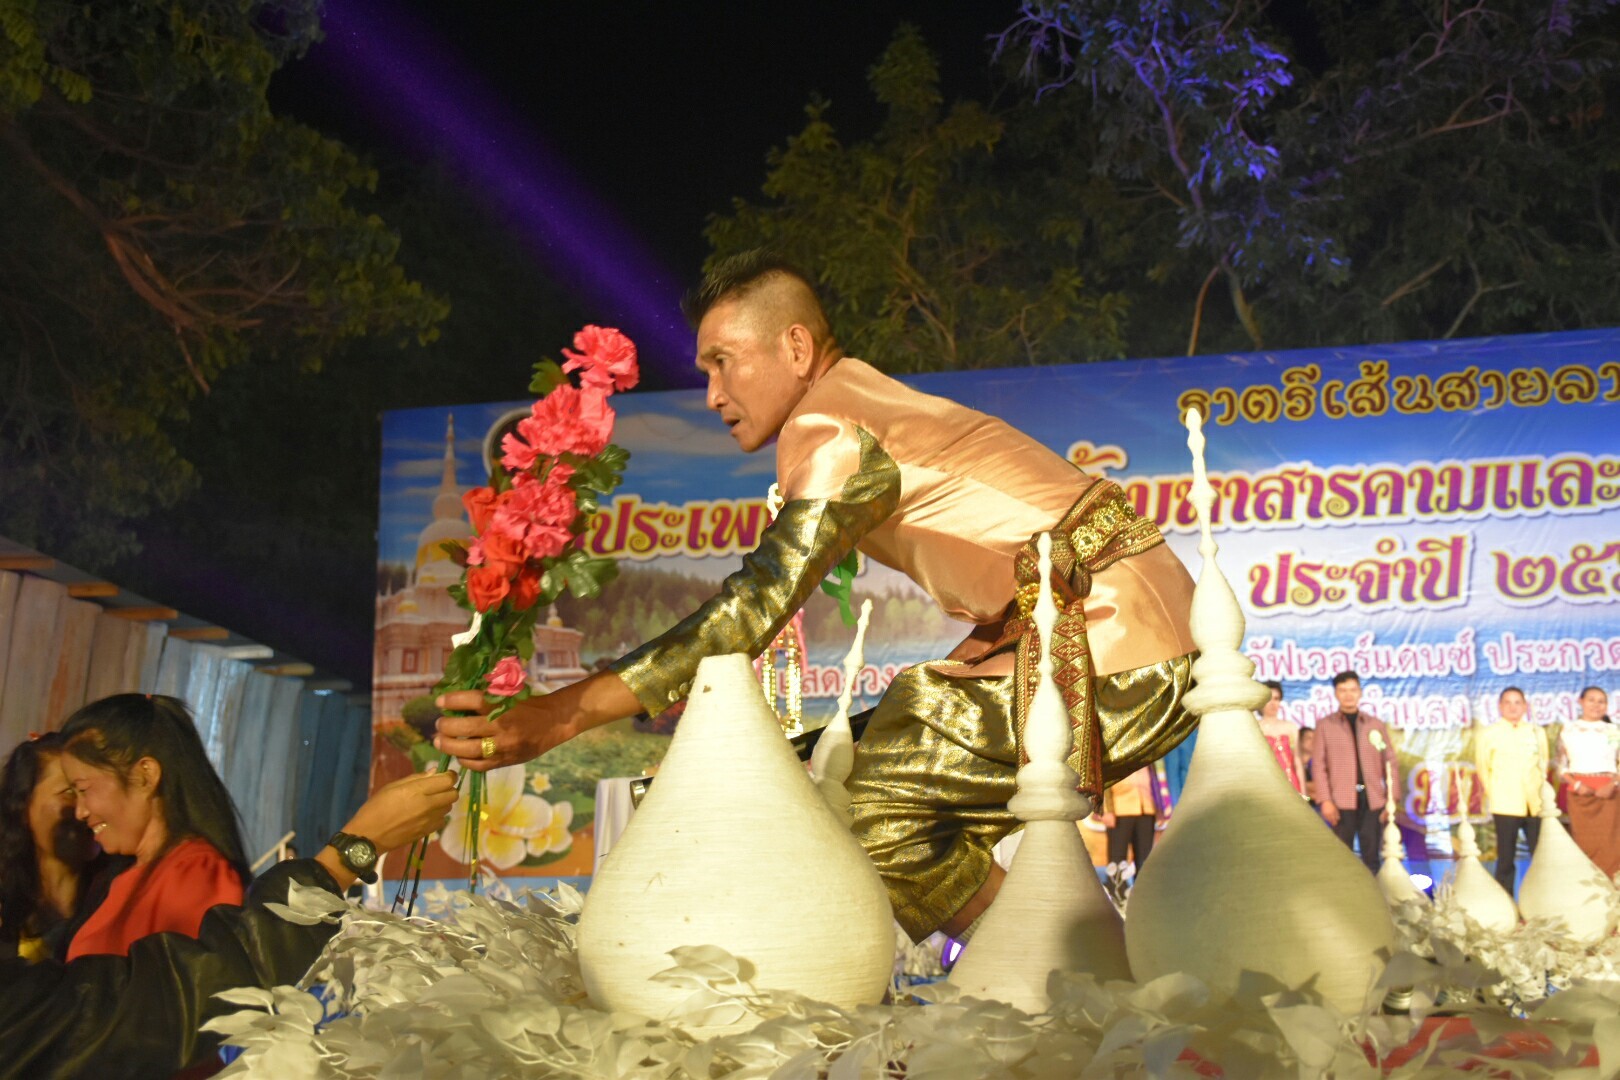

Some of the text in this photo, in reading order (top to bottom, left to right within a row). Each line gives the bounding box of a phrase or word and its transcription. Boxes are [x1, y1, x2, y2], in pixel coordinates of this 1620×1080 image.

[573, 501, 774, 555] ประเพ
[1249, 535, 1620, 609] ประจำปี ๒๕
